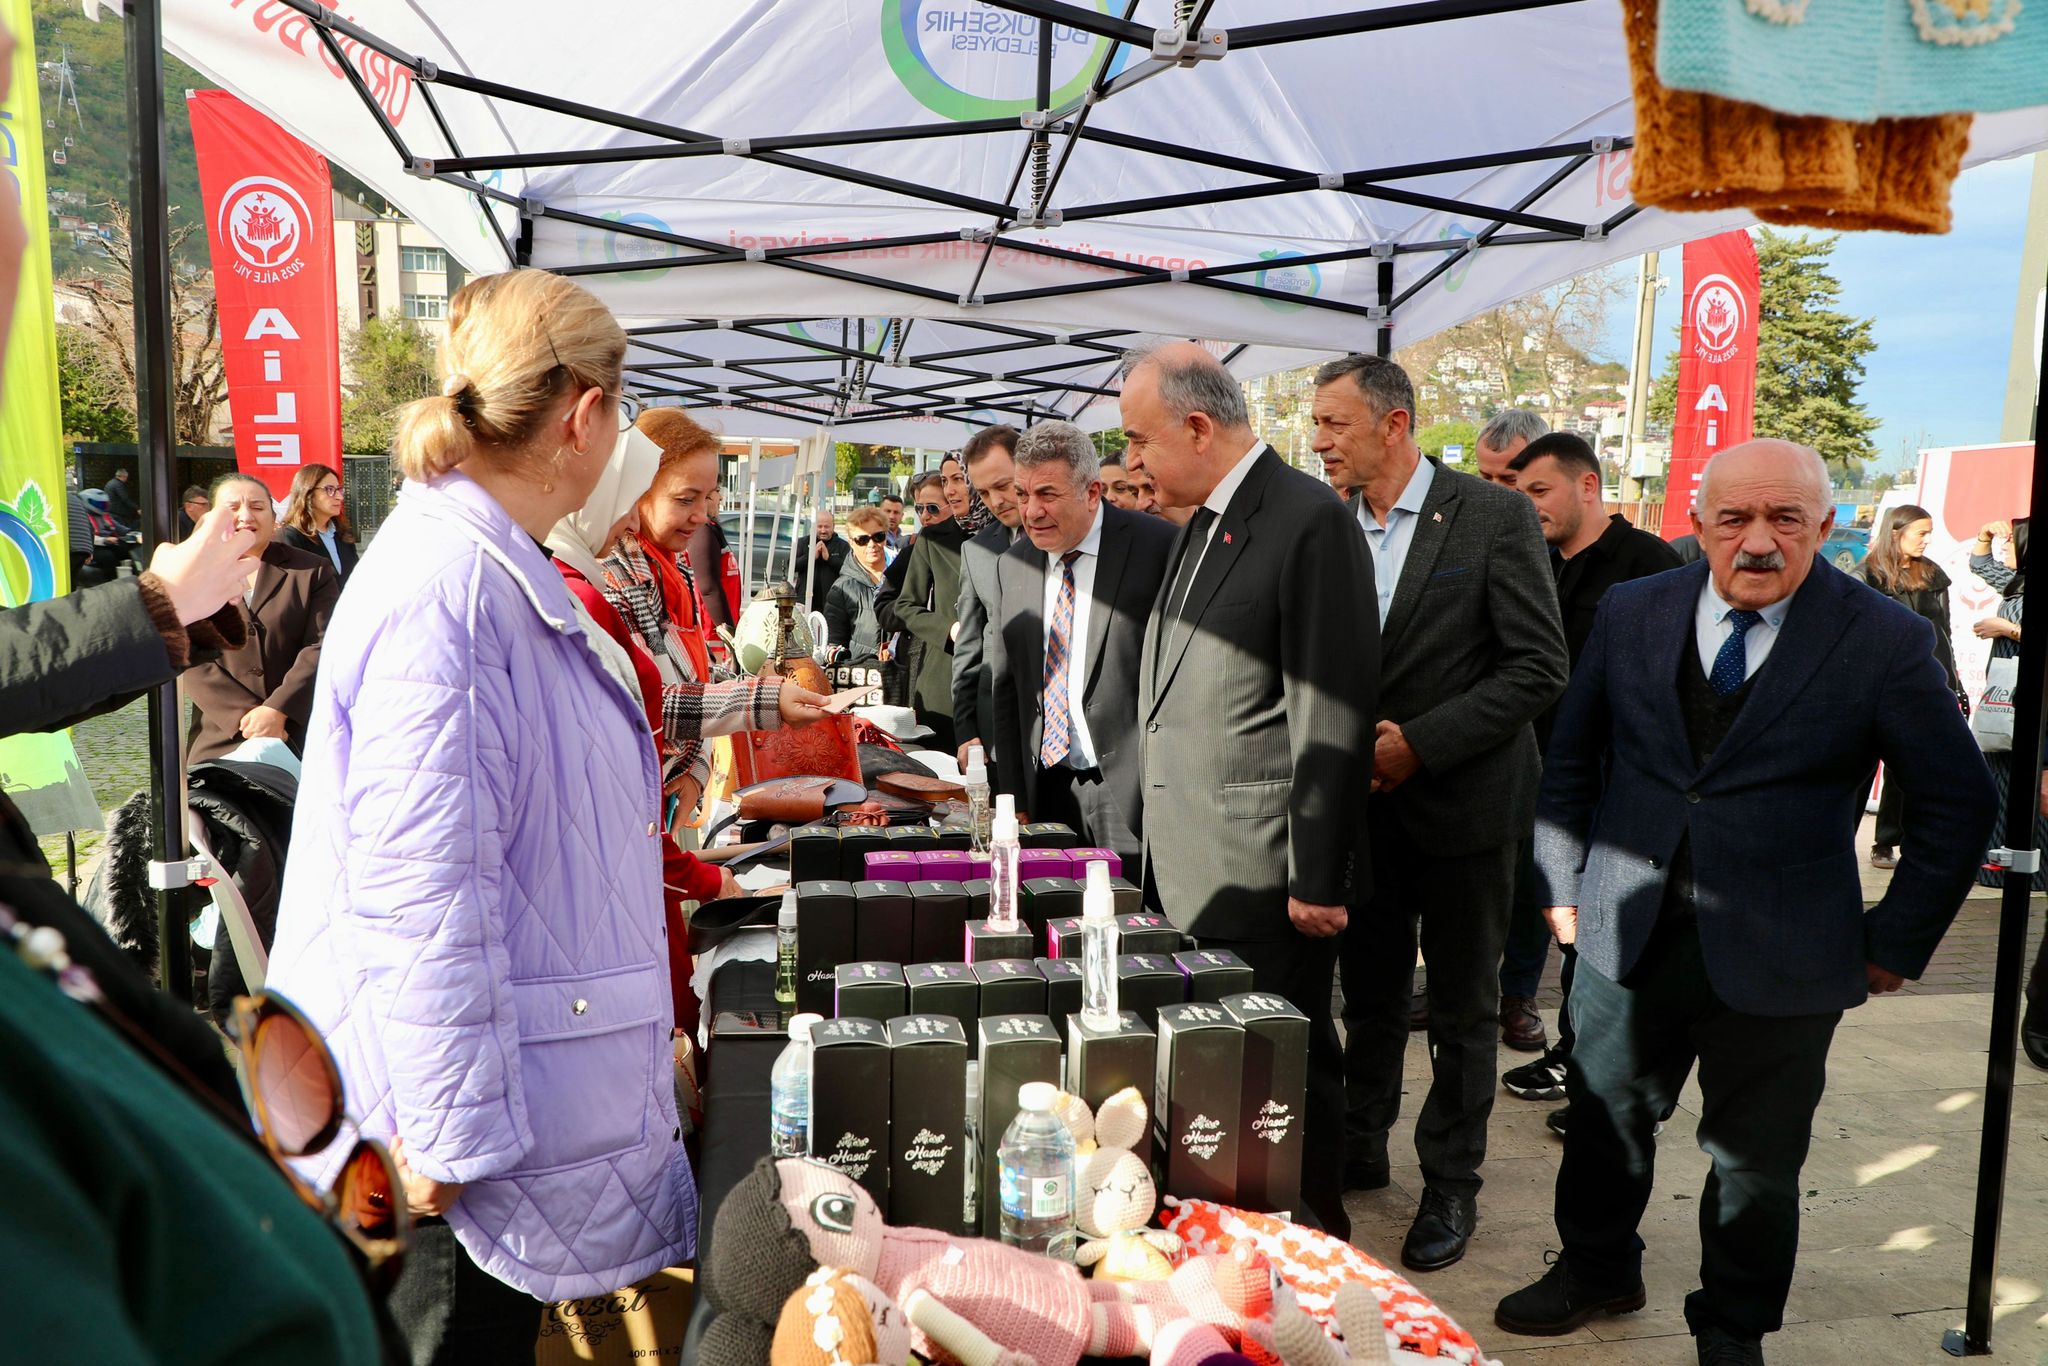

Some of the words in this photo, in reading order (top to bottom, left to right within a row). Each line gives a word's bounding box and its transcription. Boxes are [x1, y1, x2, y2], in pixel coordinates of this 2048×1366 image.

[807, 970, 836, 982] Hasa
[1252, 1115, 1295, 1130] Hasat
[1181, 1130, 1226, 1145] Hasat
[828, 1149, 877, 1165] Hasat
[904, 1145, 953, 1161] Hasat
[649, 1347, 661, 1357] ml
